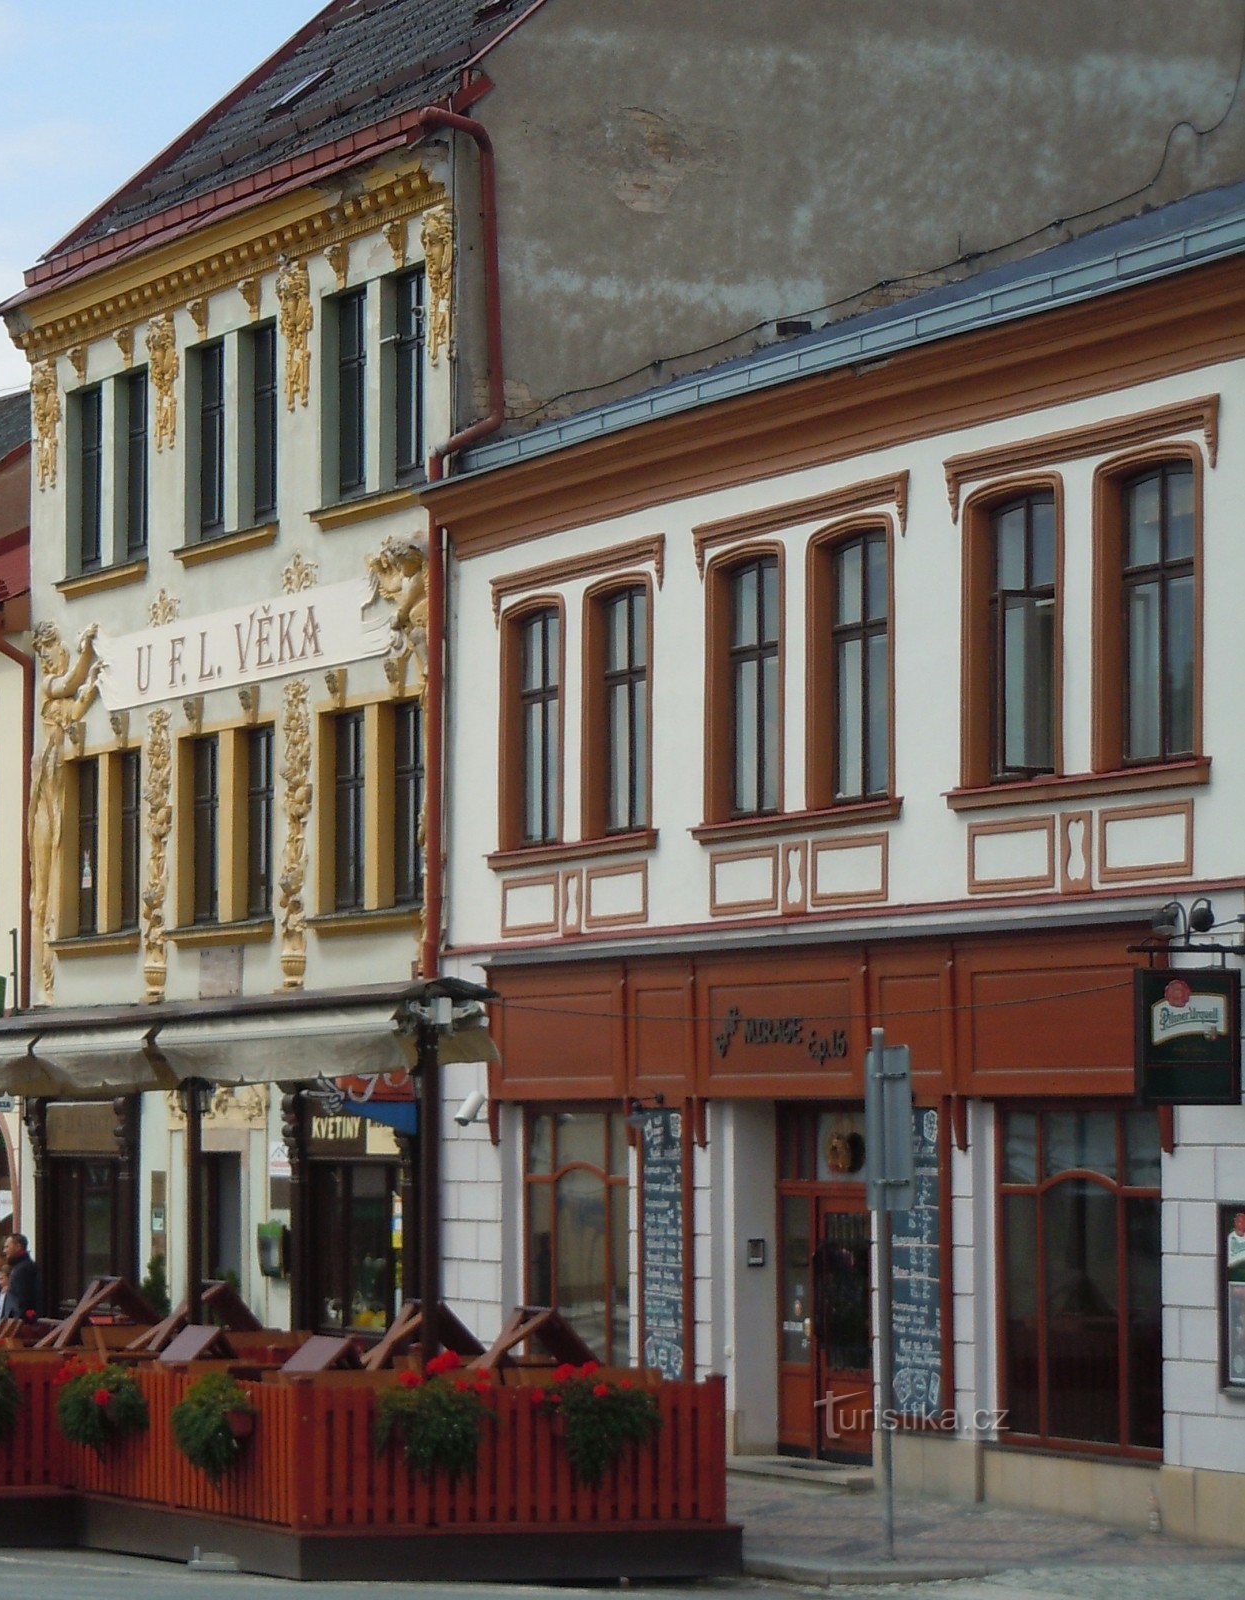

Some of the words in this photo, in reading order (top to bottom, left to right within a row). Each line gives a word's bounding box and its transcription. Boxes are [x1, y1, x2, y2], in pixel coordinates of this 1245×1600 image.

[137, 644, 152, 693] U
[169, 636, 186, 687] F.
[198, 631, 221, 681] L.
[234, 603, 323, 674] VĚKA
[744, 1017, 804, 1044] MIRAGE
